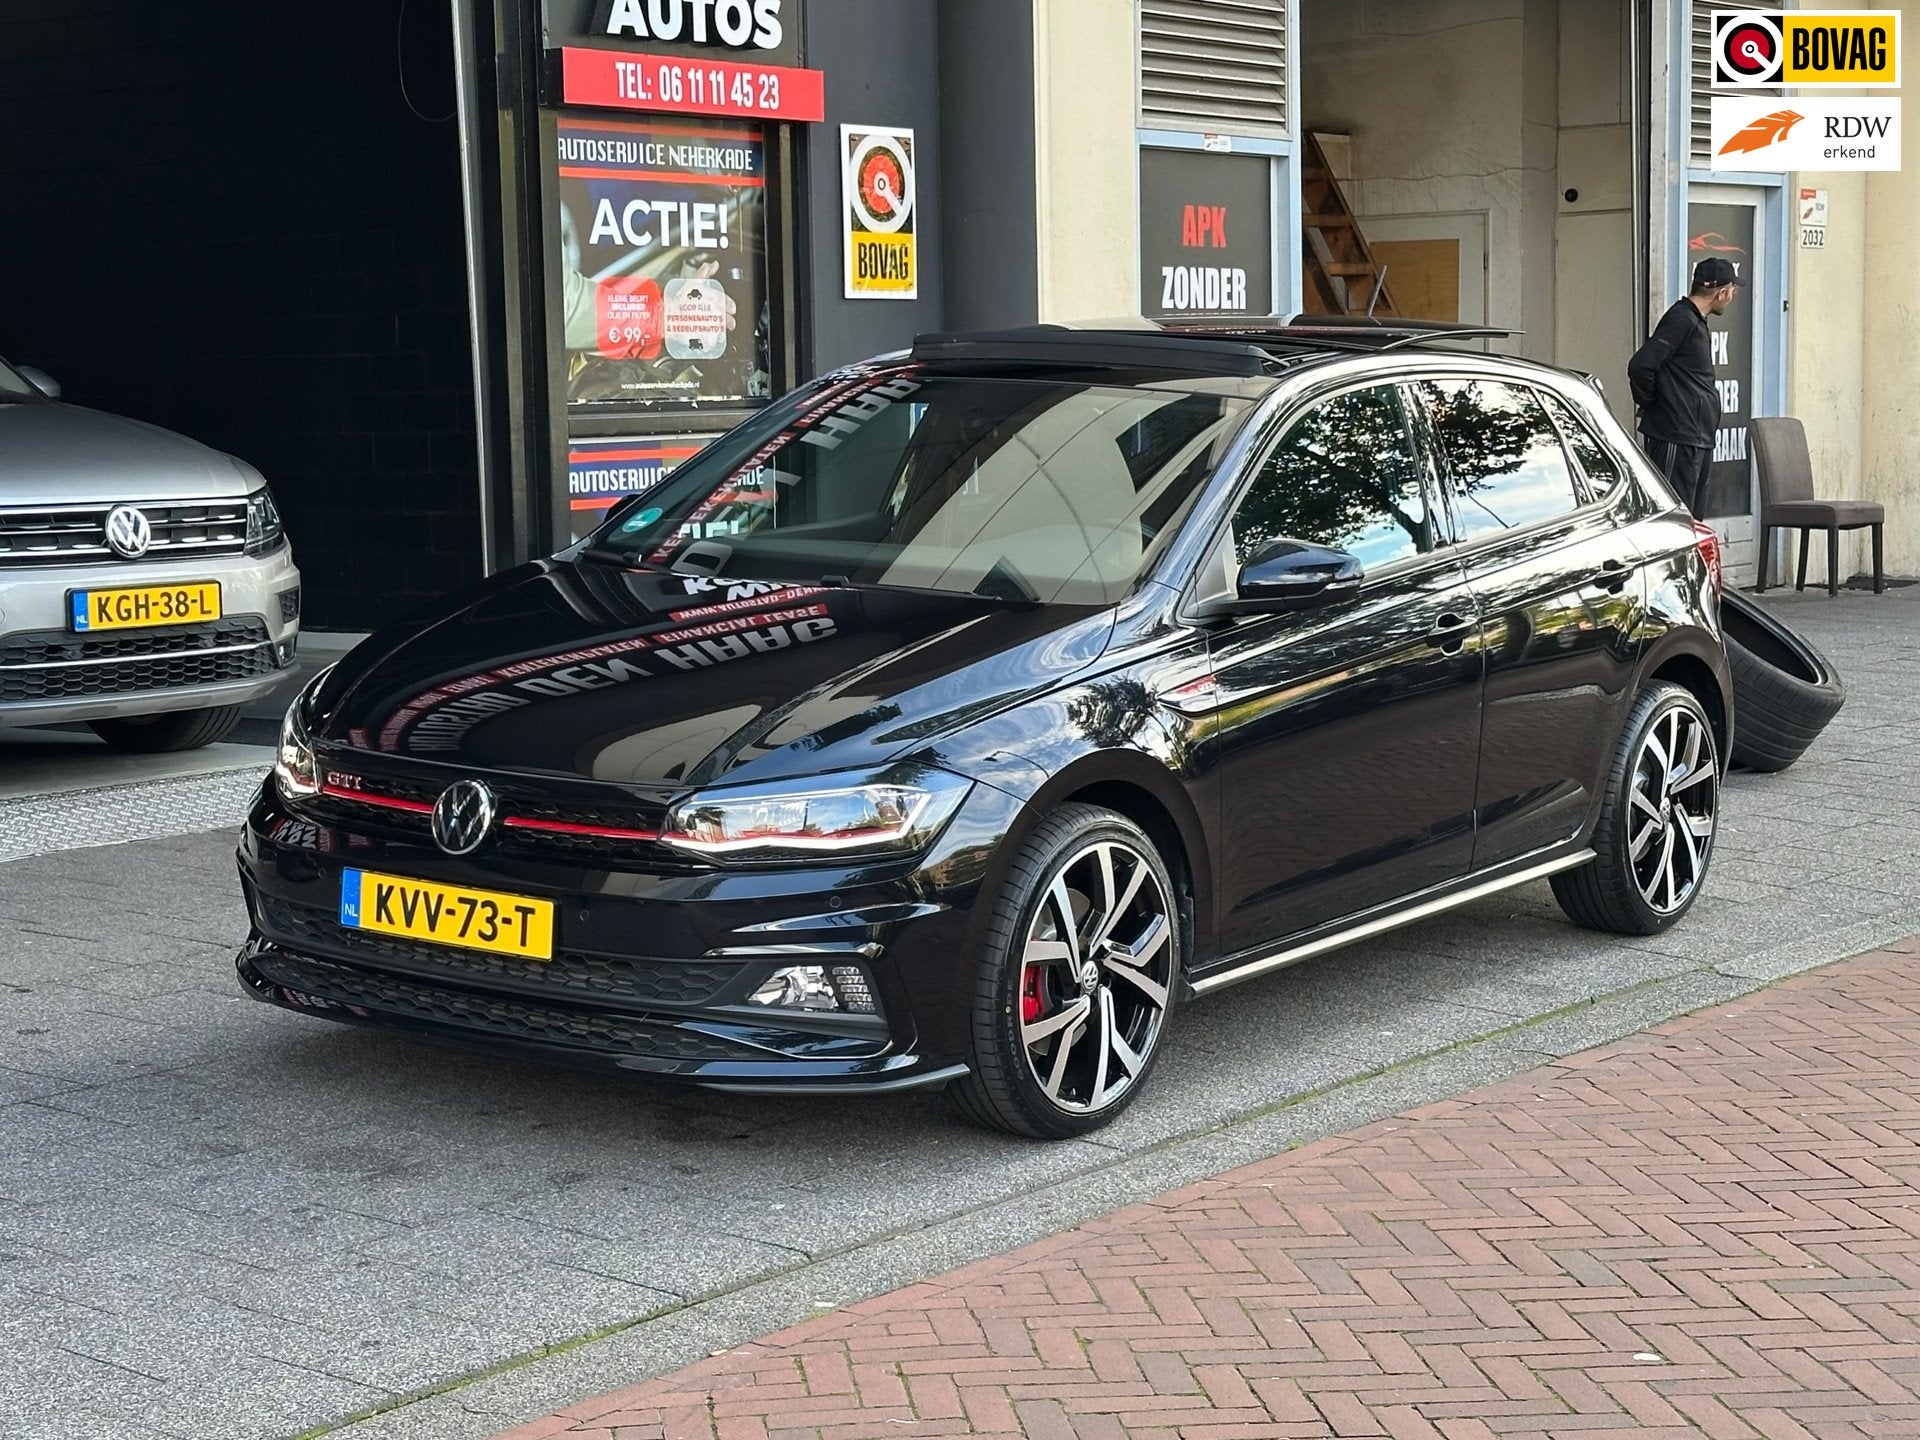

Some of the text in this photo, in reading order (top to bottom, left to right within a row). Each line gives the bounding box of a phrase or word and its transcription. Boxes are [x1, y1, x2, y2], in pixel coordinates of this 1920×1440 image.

[606, 0, 783, 49] AUTOS
[615, 62, 780, 110] TEL: 06 11 11 45 23
[558, 138, 754, 171] AUTOSERVICE NEHERKADE
[589, 198, 729, 249] ACTIE!
[1182, 205, 1227, 248] APK
[1803, 229, 1824, 246] 2032
[858, 242, 909, 281] BOVAG
[1162, 266, 1246, 309] ZONDER
[608, 326, 651, 346] € 99,-
[1711, 331, 1728, 365] PK
[1713, 427, 1746, 462] RAAK
[76, 589, 213, 625] NL KGH-38-L
[327, 771, 362, 791] GTI
[344, 883, 536, 948] NL KVV-73-T
